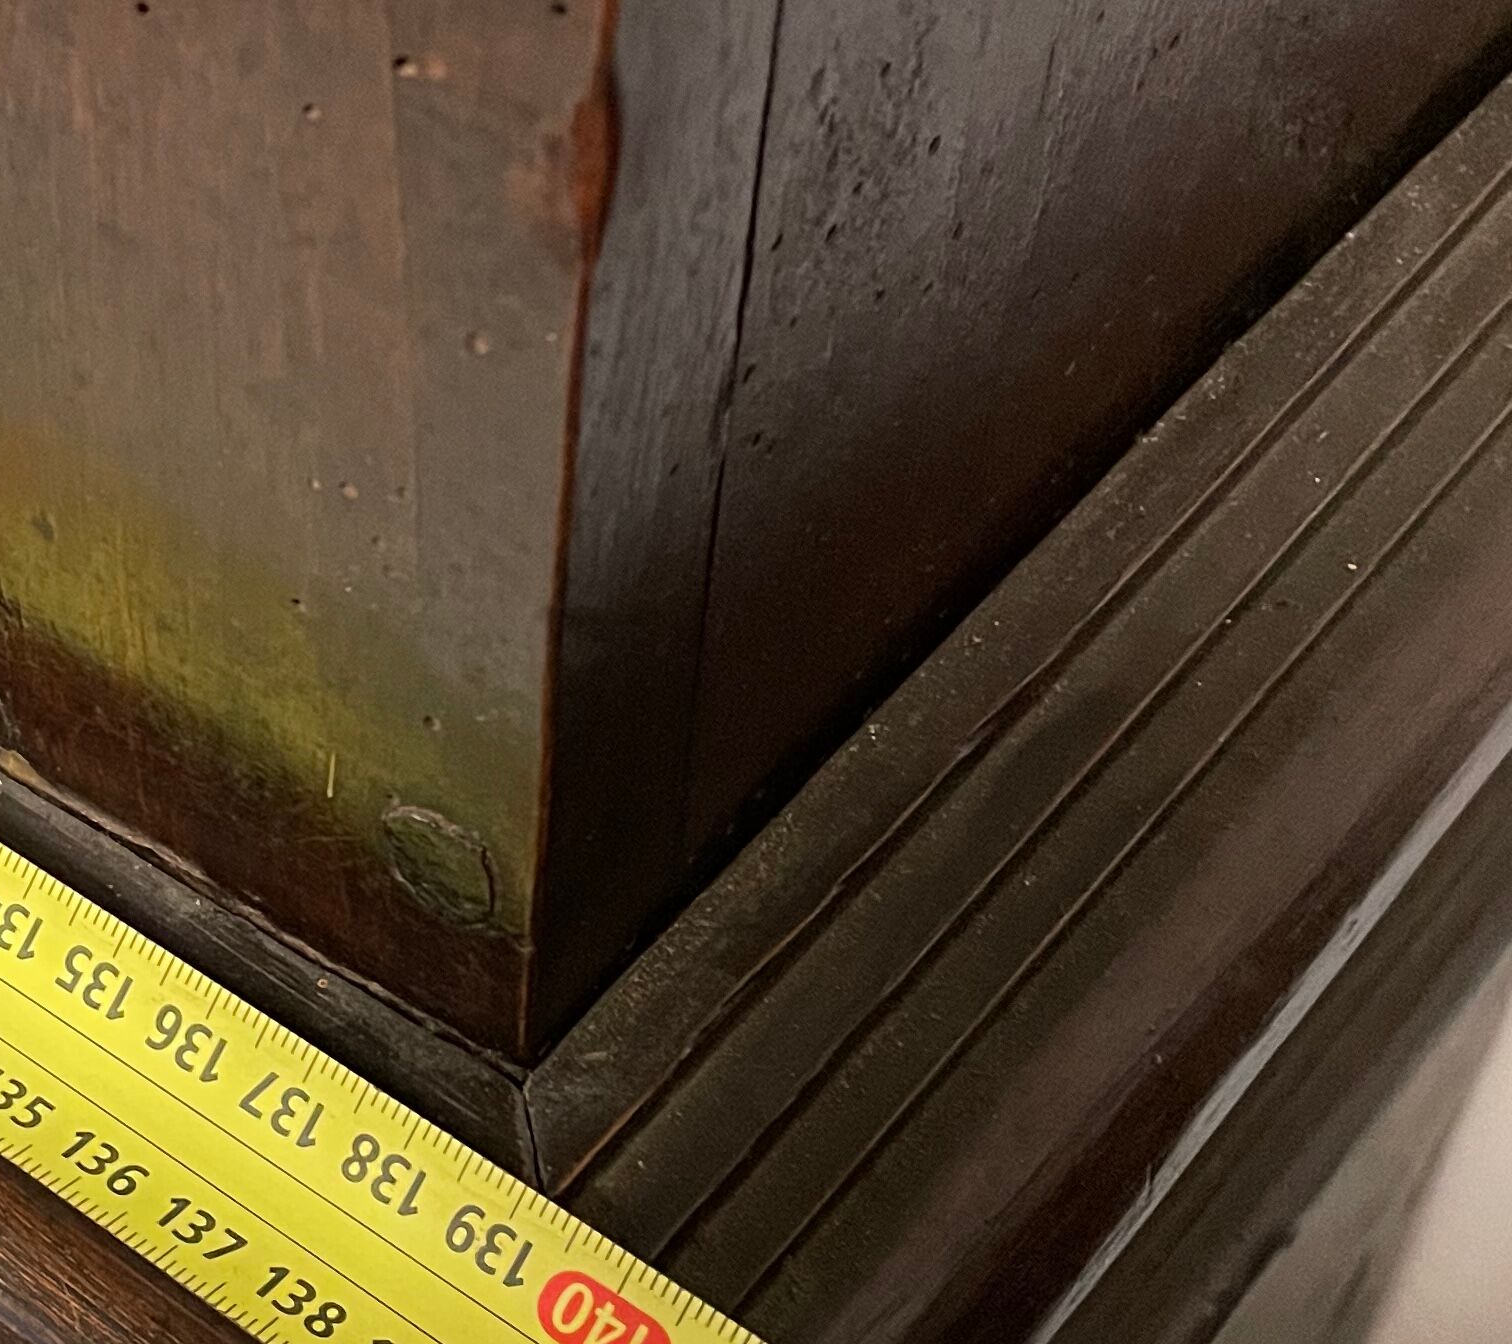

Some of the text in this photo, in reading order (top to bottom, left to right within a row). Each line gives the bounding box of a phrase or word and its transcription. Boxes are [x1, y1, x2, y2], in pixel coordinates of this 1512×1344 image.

[55, 944, 138, 1021] 135
[144, 1003, 229, 1084] 136
[239, 1070, 327, 1148] 137
[341, 1132, 430, 1217] 138
[444, 1204, 535, 1288] 139
[61, 1130, 150, 1196] 136
[157, 1195, 248, 1260] 137
[256, 1265, 349, 1338] 138
